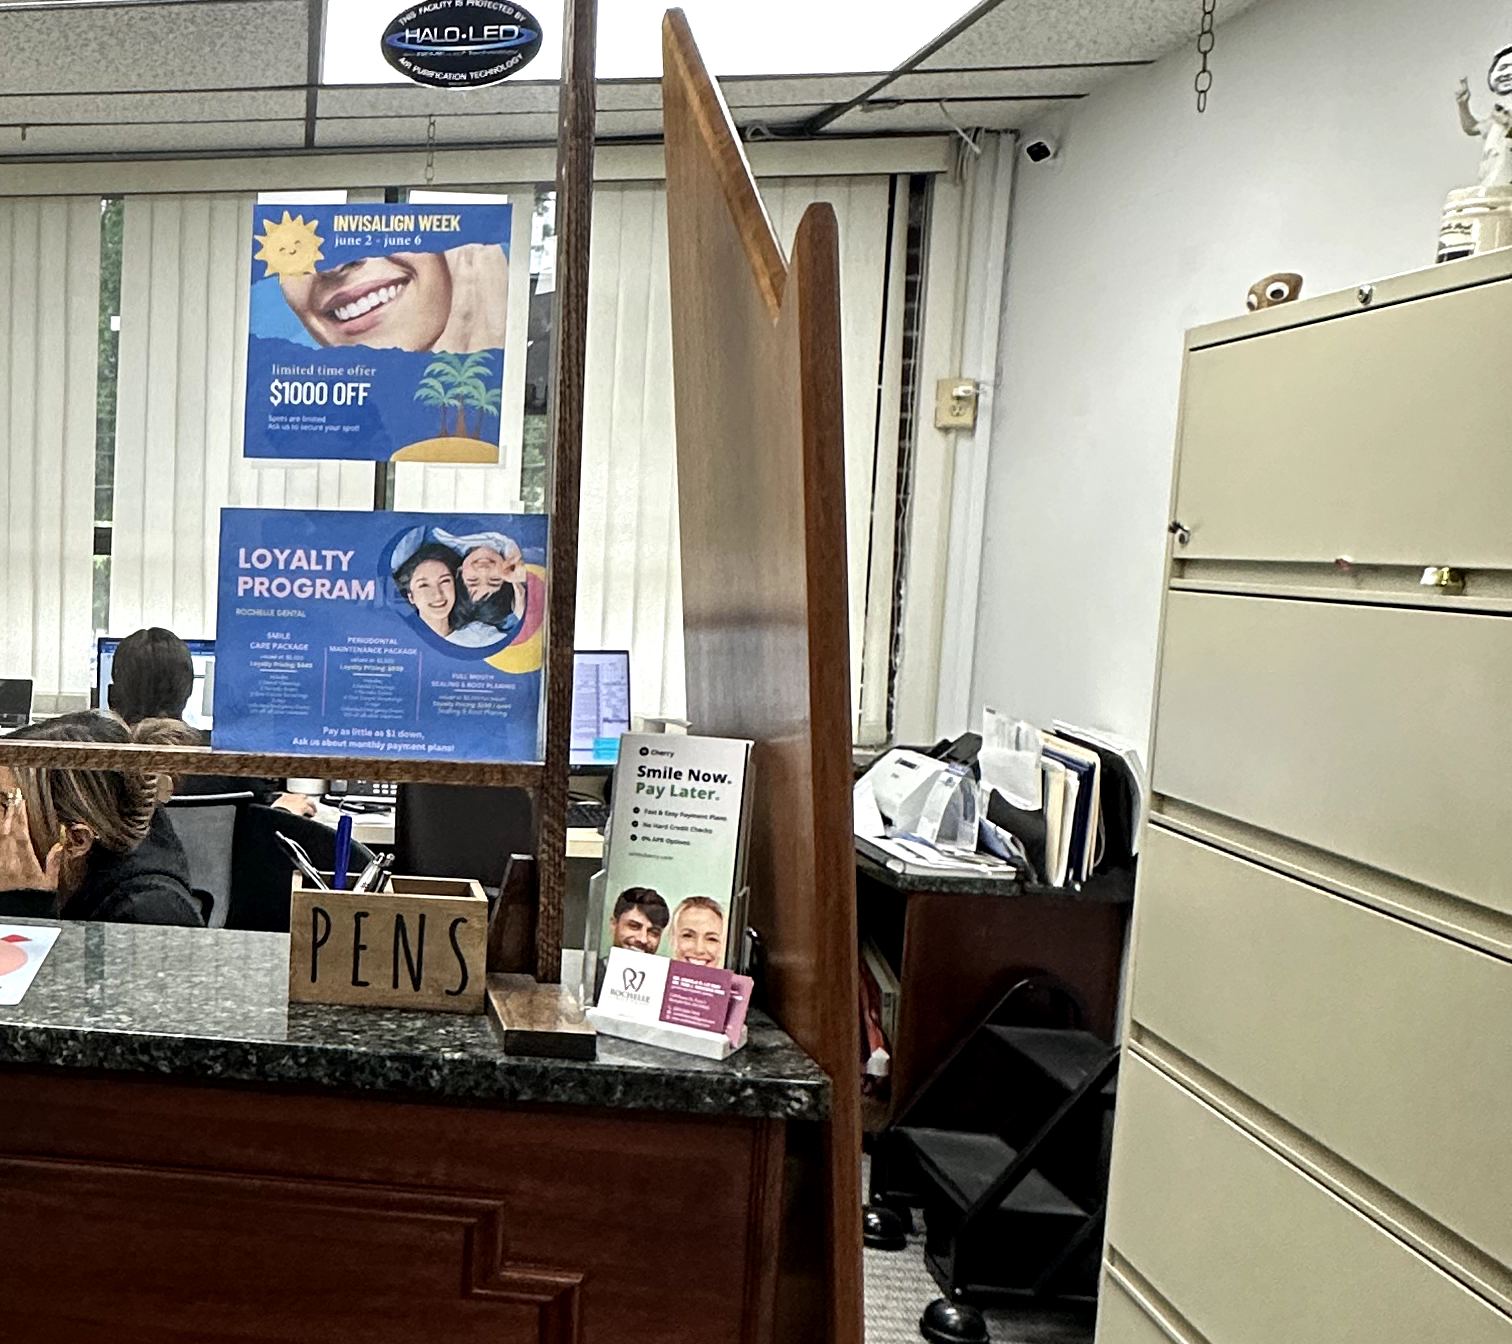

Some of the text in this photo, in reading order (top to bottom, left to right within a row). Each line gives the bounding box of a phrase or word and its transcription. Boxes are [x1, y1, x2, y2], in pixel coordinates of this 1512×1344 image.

[398, 0, 527, 26] THIS FACILITY IS PROTECTED BY
[398, 57, 411, 69] AIR
[412, 66, 467, 81] PURIFICATION
[469, 53, 523, 80] TECHNOLOGY
[333, 214, 461, 232] INVISALIGN WEEK
[334, 235, 362, 248] june
[365, 235, 373, 246] 2
[383, 235, 411, 249] june
[414, 235, 422, 246] 6
[272, 364, 377, 377] limited time offer
[269, 378, 371, 407] $1000 OFF
[238, 547, 355, 572] LOYALTY
[237, 577, 376, 601] PROGRAM
[323, 726, 339, 737] Pay
[340, 728, 350, 736] as
[351, 727, 373, 737] little
[374, 729, 385, 737] as
[292, 737, 455, 753] Ask us about monthly payment plans!
[650, 749, 675, 758] Cherry
[637, 765, 732, 785] Smile Now.
[635, 782, 720, 801] Pay Later.
[643, 808, 657, 816] Fast
[664, 810, 679, 819] Easy
[679, 812, 708, 820] Payment
[709, 814, 728, 822] Plans
[653, 822, 669, 830] Hard
[669, 824, 689, 832] Credit
[666, 838, 691, 846] Options
[310, 906, 469, 997] PENS
[610, 988, 651, 1003] ROCHELLE
